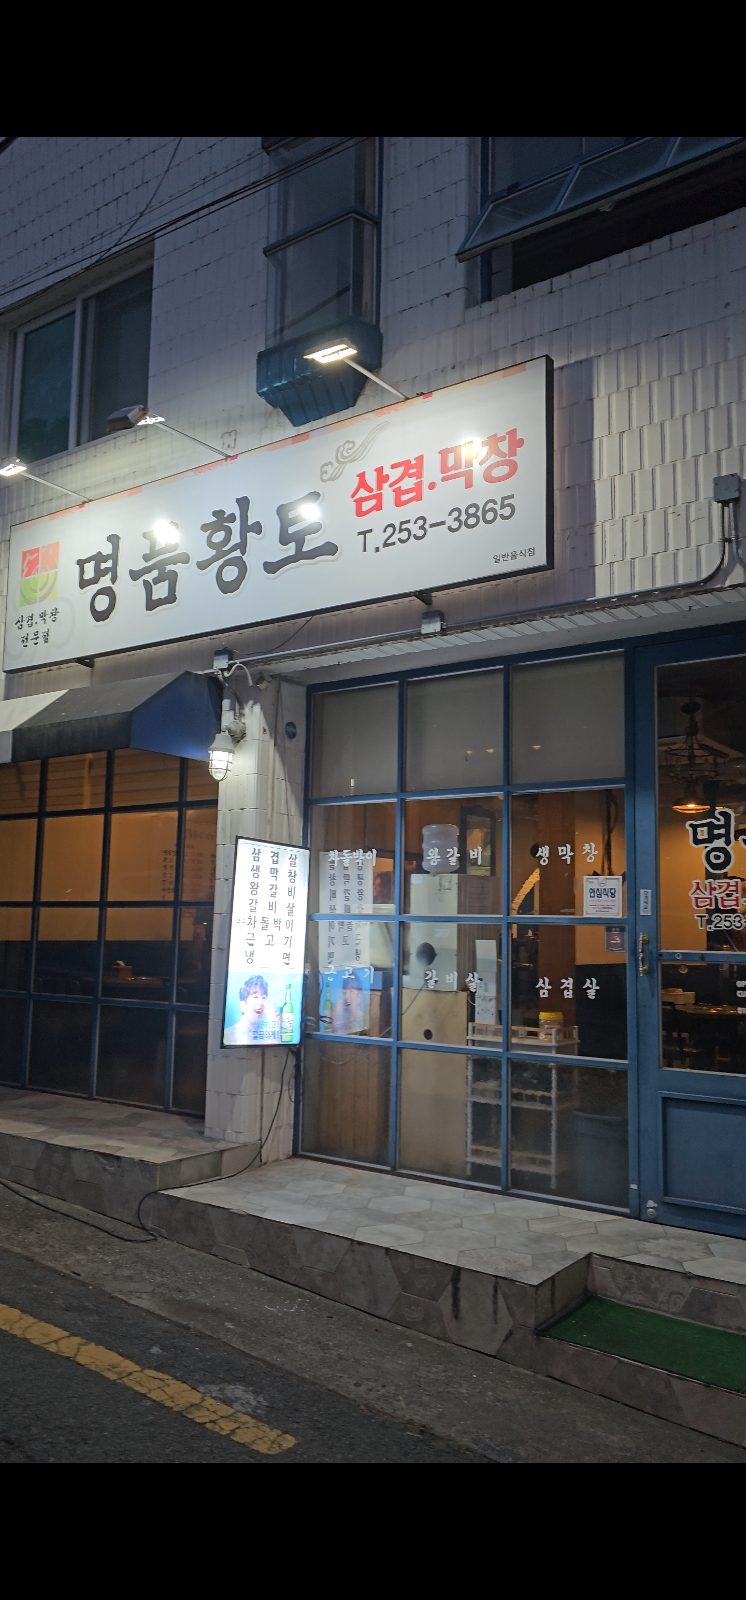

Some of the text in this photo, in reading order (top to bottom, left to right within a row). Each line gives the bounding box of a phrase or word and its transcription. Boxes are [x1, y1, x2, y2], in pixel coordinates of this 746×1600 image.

[351, 429, 525, 518] 삼겹.막창
[357, 494, 516, 555] T.253-3865
[77, 491, 338, 622] 명품황토
[493, 547, 536, 564] 일반음식점
[686, 809, 746, 873] 명
[327, 849, 377, 868] 차돌박이
[426, 846, 483, 867] 왕갈비
[536, 843, 598, 866] 생막창
[588, 887, 617, 899] 안심식당
[690, 879, 746, 909] 삼겹
[424, 970, 480, 991] 갈비살
[535, 977, 600, 999] 삼겹살
